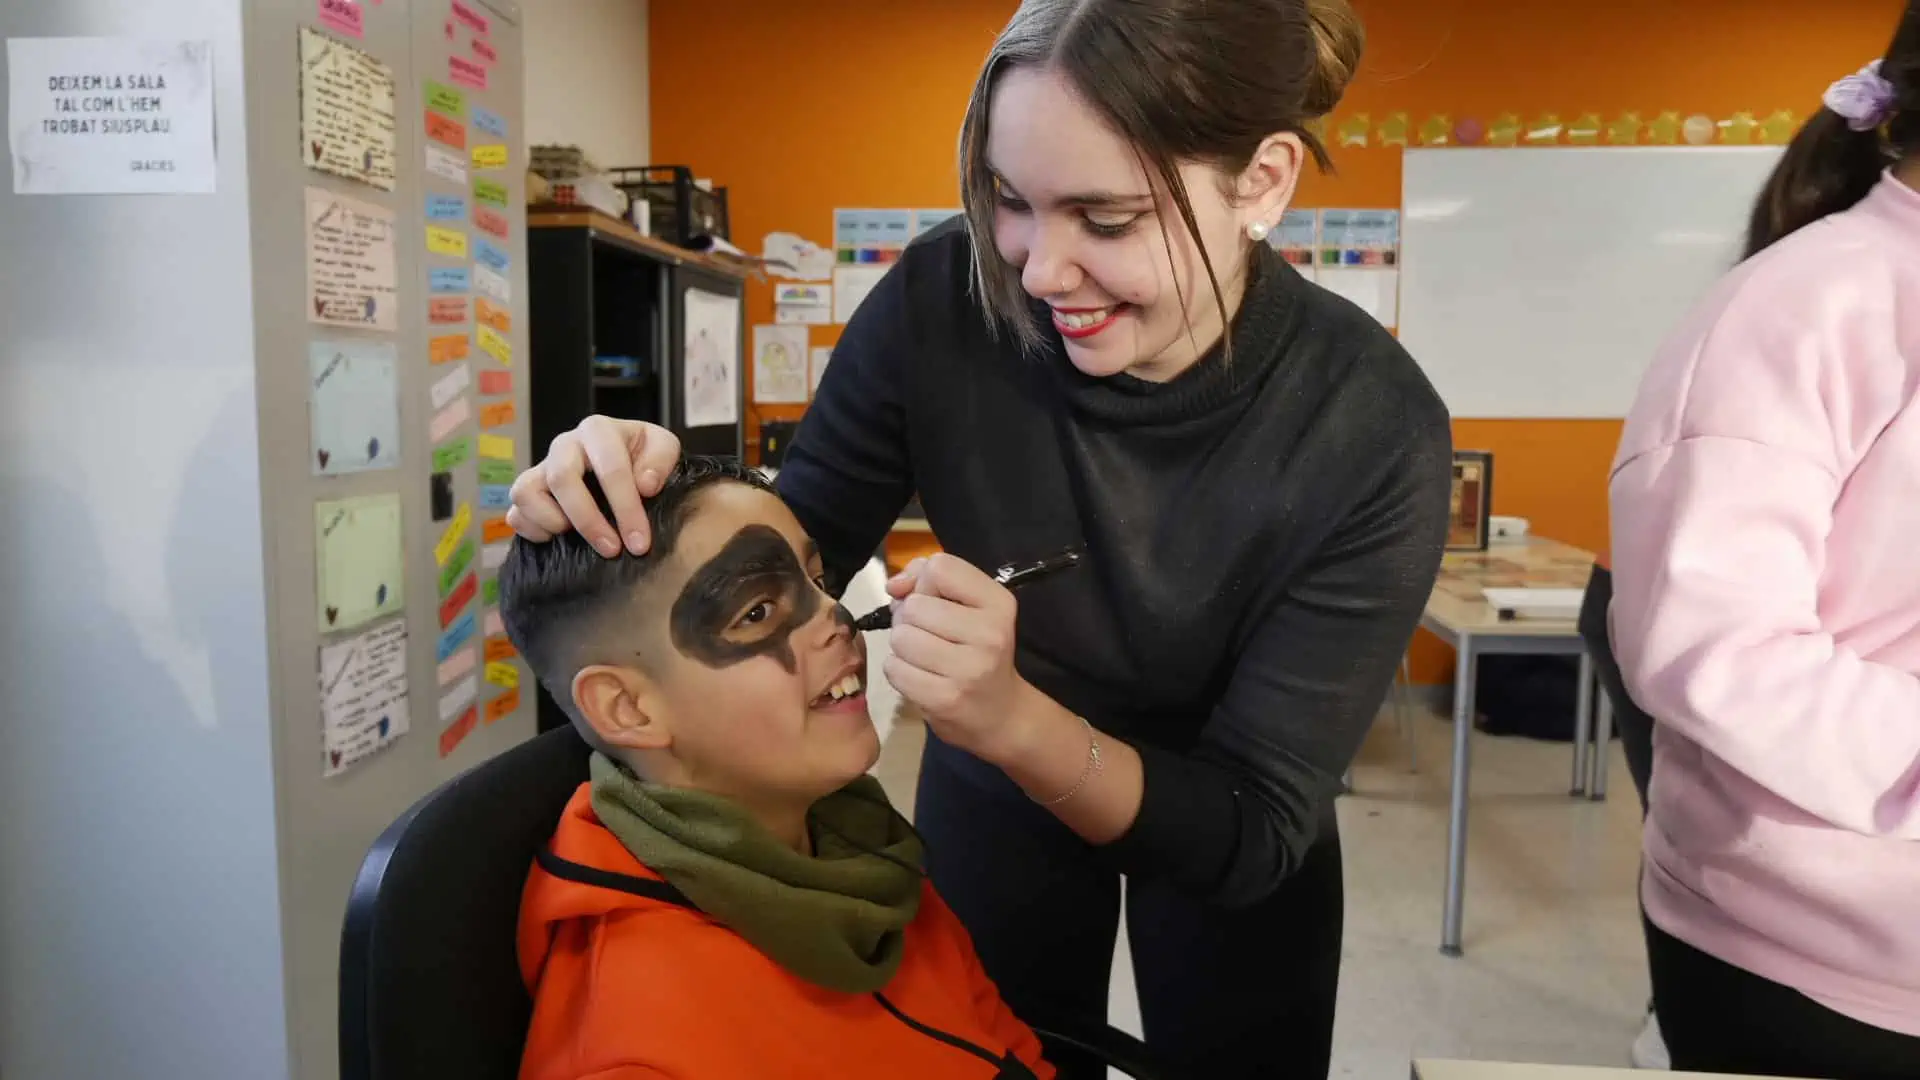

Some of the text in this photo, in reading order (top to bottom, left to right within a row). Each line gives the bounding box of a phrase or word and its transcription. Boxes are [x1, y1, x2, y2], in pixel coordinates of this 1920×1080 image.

[49, 74, 166, 91] DEIXEM LA SALA
[55, 97, 79, 112] TAL
[82, 97, 113, 112] COM
[43, 119, 97, 134] TROBAT
